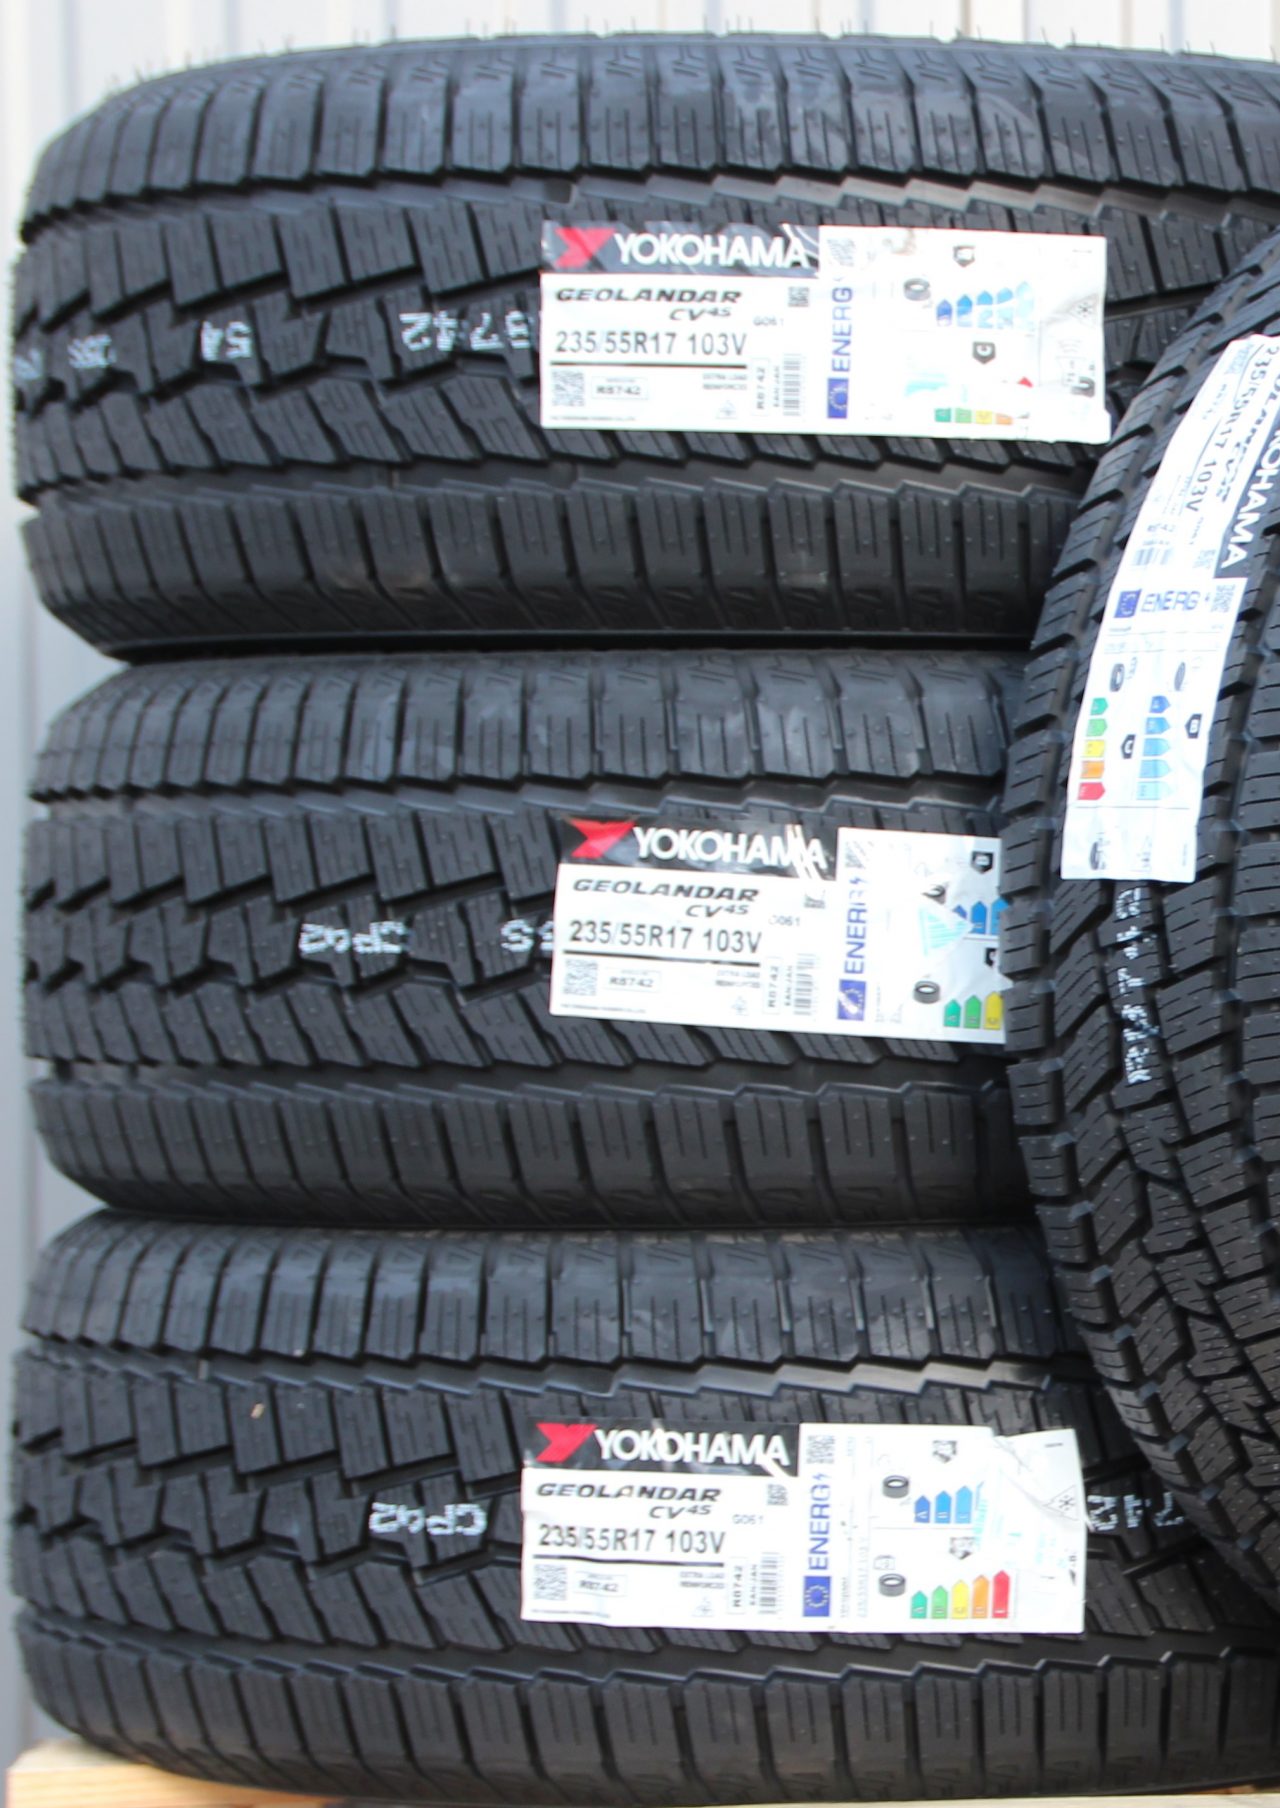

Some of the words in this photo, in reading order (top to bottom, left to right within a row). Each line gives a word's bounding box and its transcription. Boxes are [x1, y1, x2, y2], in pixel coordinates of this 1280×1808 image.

[615, 233, 810, 268] YOKOHAMA
[556, 287, 742, 303] GEOLANDAR
[669, 307, 732, 321] CV4S
[556, 330, 677, 354] 235/55R17
[688, 333, 747, 356] 103V
[1186, 460, 1217, 512] 103V
[1140, 591, 1200, 613] ENERG
[633, 826, 828, 869] YOKOHAMA
[573, 879, 759, 901] GEOLANDAR
[686, 904, 749, 917] CV4S
[570, 920, 692, 949] 235/55R17
[703, 930, 762, 953] 103V
[594, 1429, 790, 1465] YOKOHAMA
[536, 1483, 721, 1501] GEOLANDAR
[650, 1505, 711, 1519] CV4S
[539, 1524, 656, 1551] 235/55R17
[666, 1531, 725, 1554] 103V
[809, 1484, 830, 1570] ENERG
